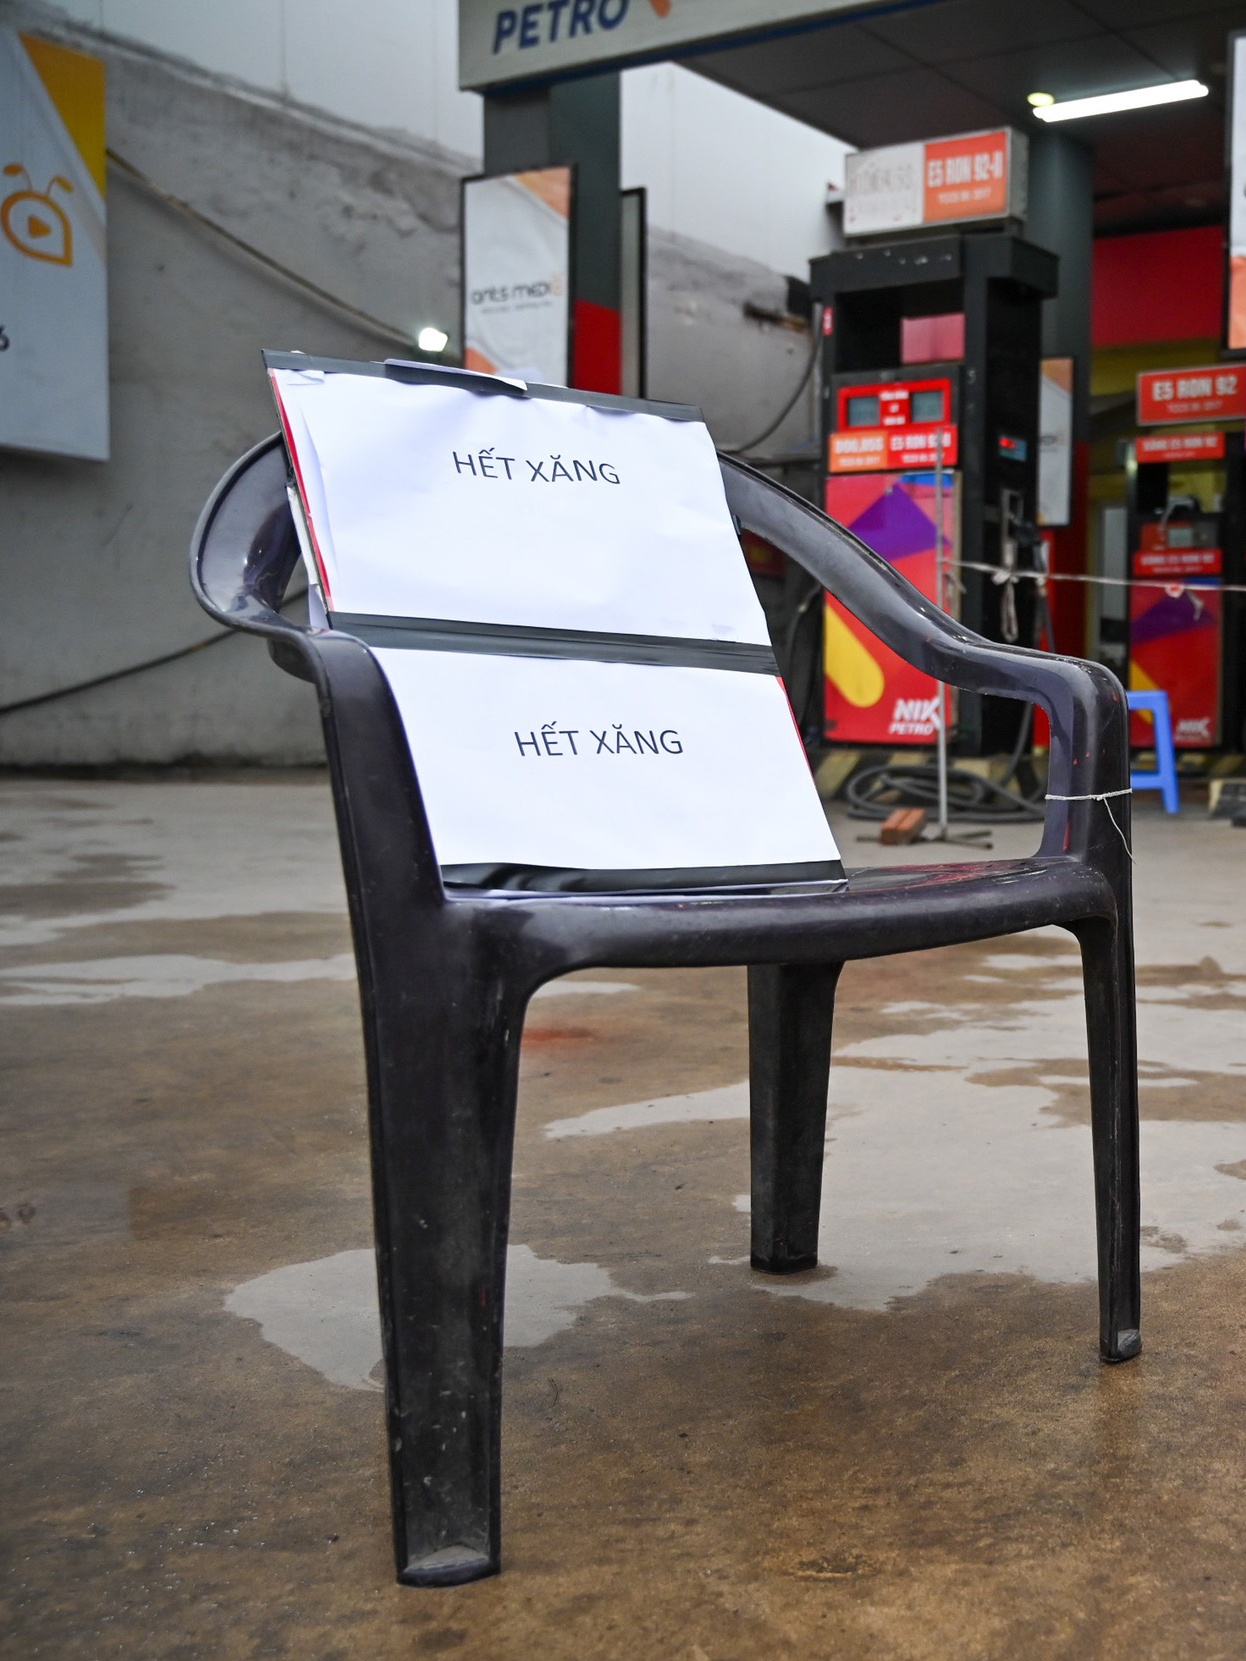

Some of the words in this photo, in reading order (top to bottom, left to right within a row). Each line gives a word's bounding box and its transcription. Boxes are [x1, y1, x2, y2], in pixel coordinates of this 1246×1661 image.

[492, 0, 631, 55] PETRO
[1153, 381, 1174, 401] E5
[1177, 378, 1212, 399] RON
[1216, 375, 1238, 396] 92
[452, 447, 515, 481] HẾT
[525, 454, 620, 485] XĂNG
[889, 722, 934, 735] PETRO
[892, 696, 940, 731] NIK
[514, 721, 579, 757] HẾT
[589, 723, 684, 755] XĂNG
